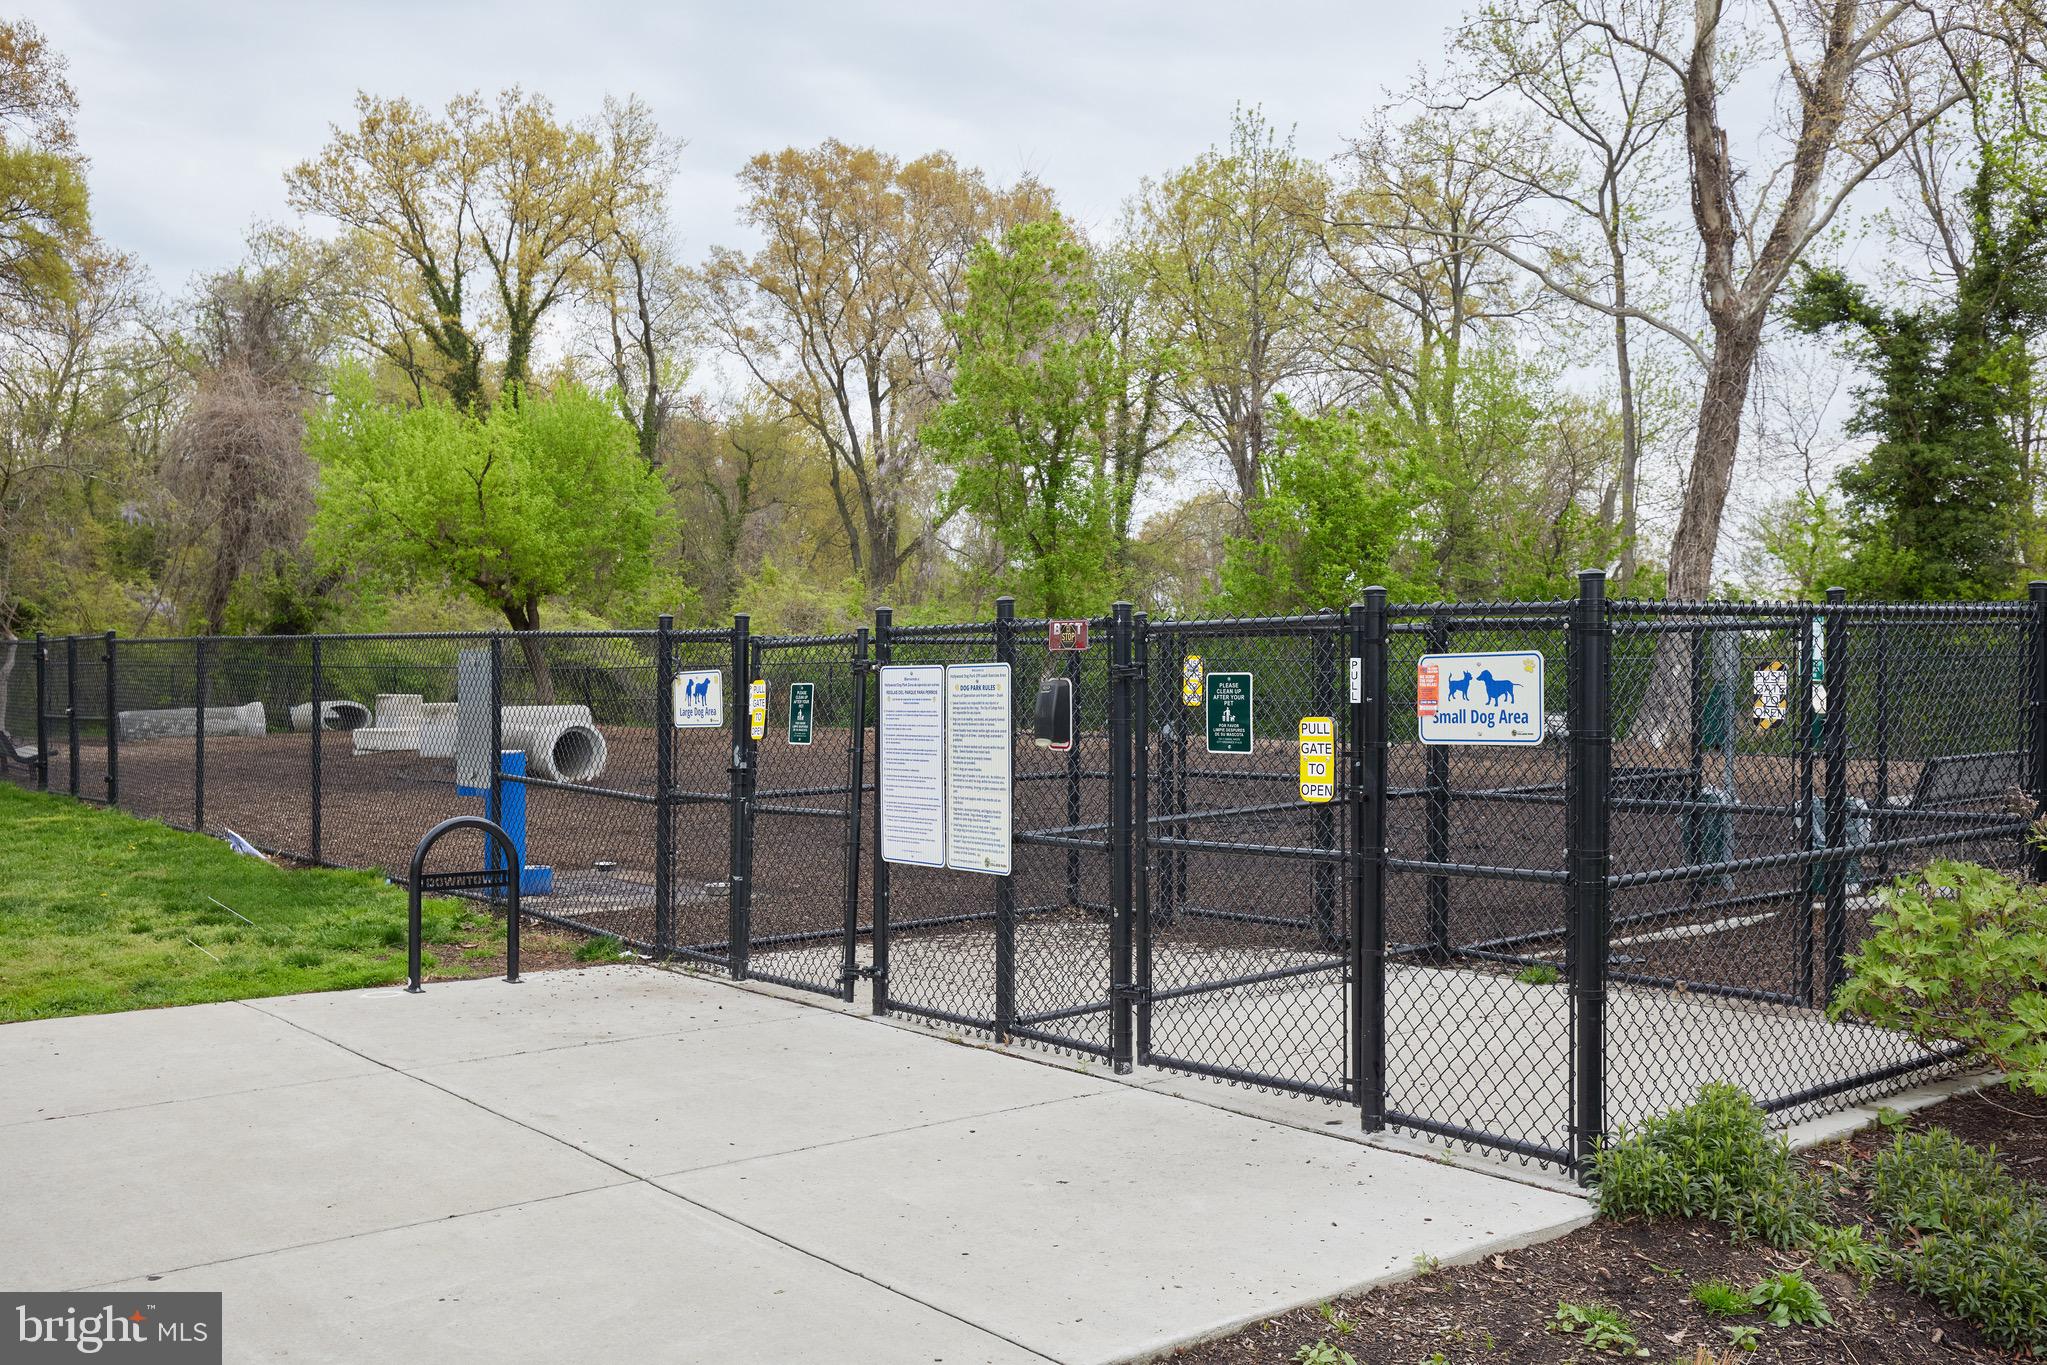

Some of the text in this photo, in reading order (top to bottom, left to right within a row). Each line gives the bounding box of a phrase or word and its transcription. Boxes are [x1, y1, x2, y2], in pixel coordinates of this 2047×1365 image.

[1061, 632, 1076, 641] STOP
[1351, 661, 1359, 701] PULL
[1755, 672, 1785, 681] PUSH
[754, 685, 764, 693] PULL
[1755, 683, 1785, 692] GATE
[753, 698, 765, 707] GATE
[1764, 696, 1779, 704] TO
[680, 707, 717, 718] Large Dog Area
[755, 712, 763, 721] TO
[1754, 708, 1786, 717] OPEN
[1433, 709, 1529, 728] Small Dog Area
[752, 727, 763, 736] OPEN
[1301, 723, 1330, 735] PULL
[1301, 743, 1332, 754] GATE
[1309, 763, 1325, 775] TO
[1301, 784, 1333, 797] OPEN
[426, 874, 504, 888] DOWNTOWN
